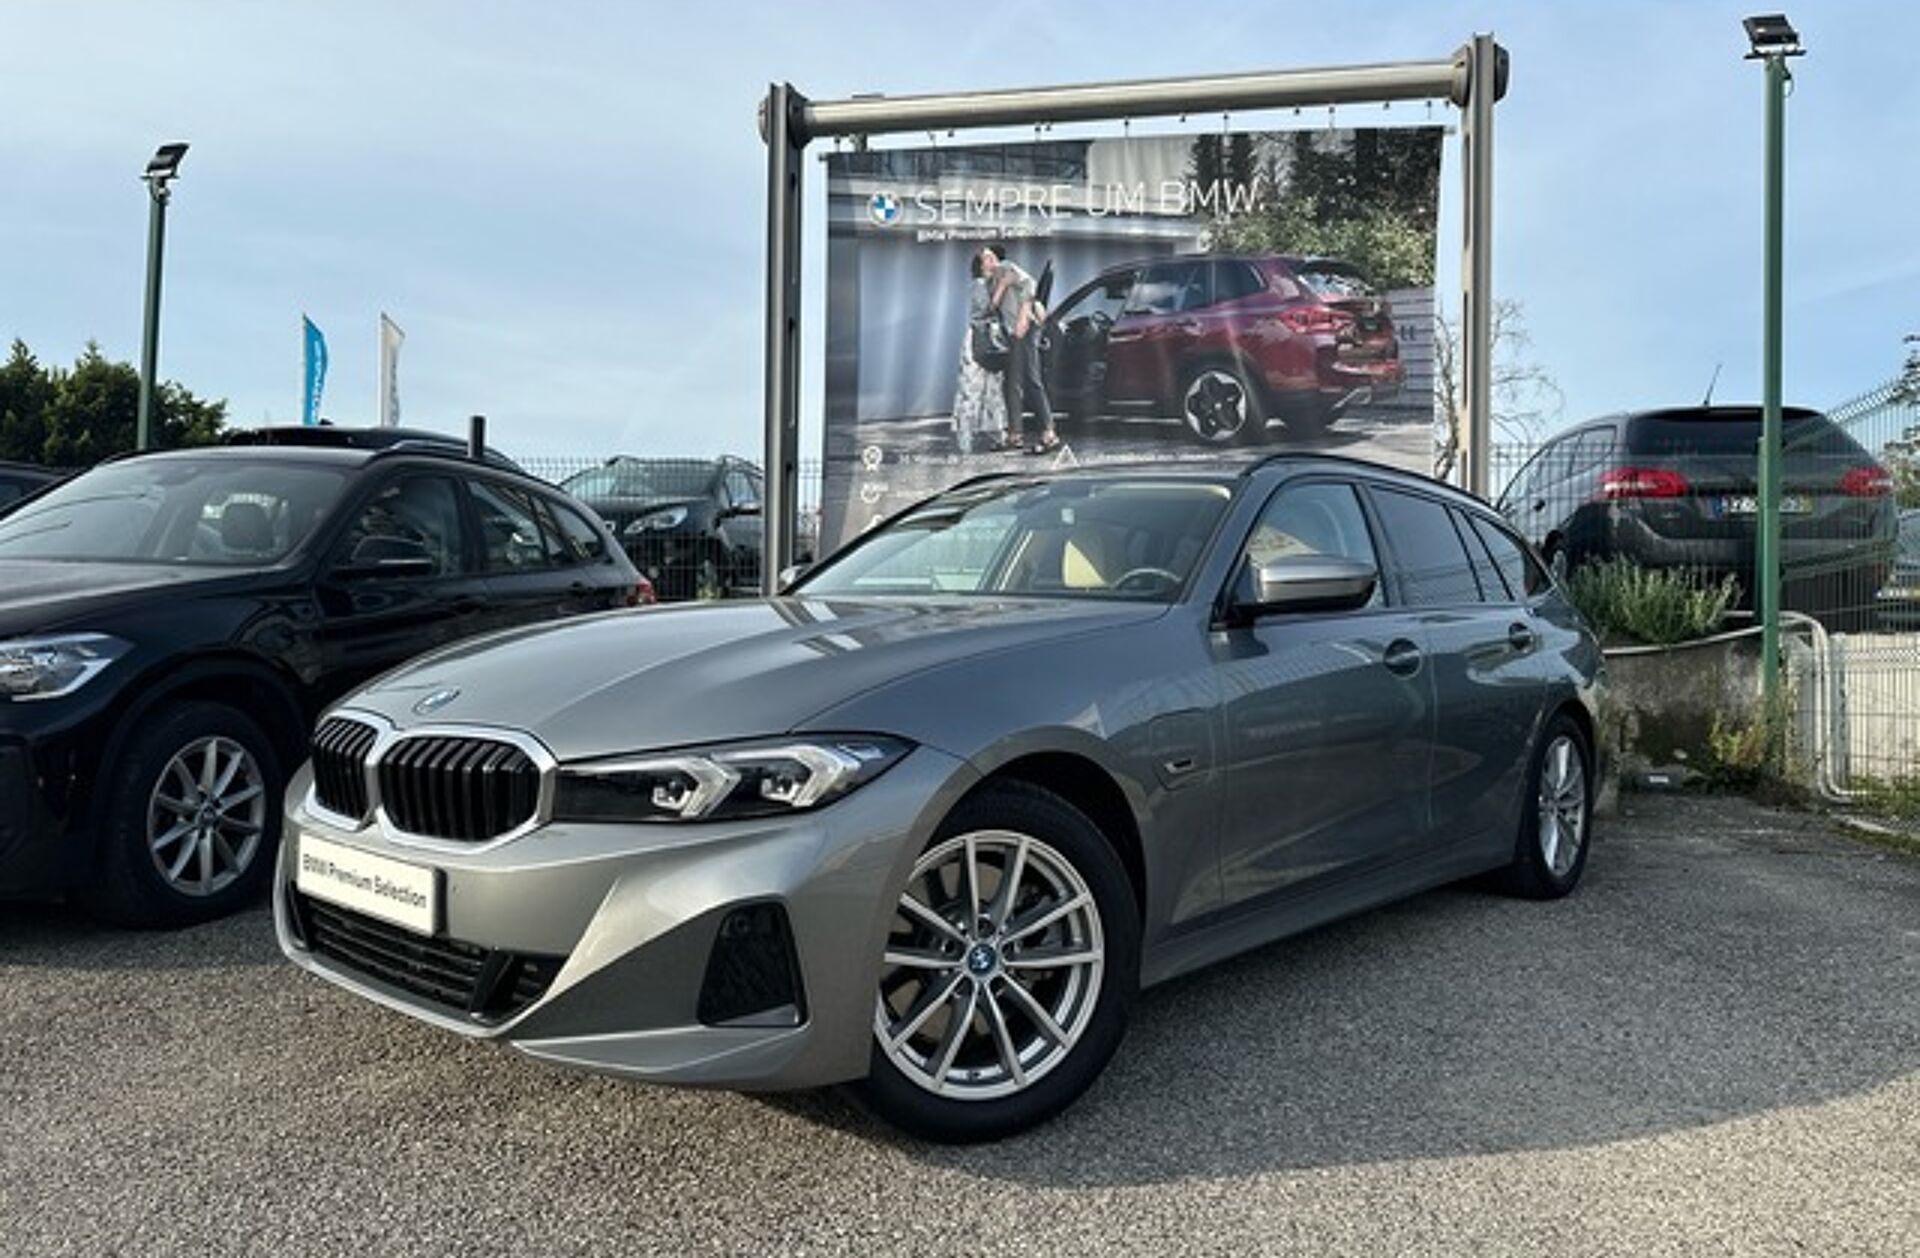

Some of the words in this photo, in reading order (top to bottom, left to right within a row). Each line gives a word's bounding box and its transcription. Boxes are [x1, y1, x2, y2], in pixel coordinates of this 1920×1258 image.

[915, 184, 1072, 225] SEMPRE
[1087, 181, 1145, 216] UM
[1160, 175, 1264, 217] BMW.
[303, 853, 328, 875] BMW
[328, 861, 373, 893] Premium
[374, 875, 427, 909] Selection
